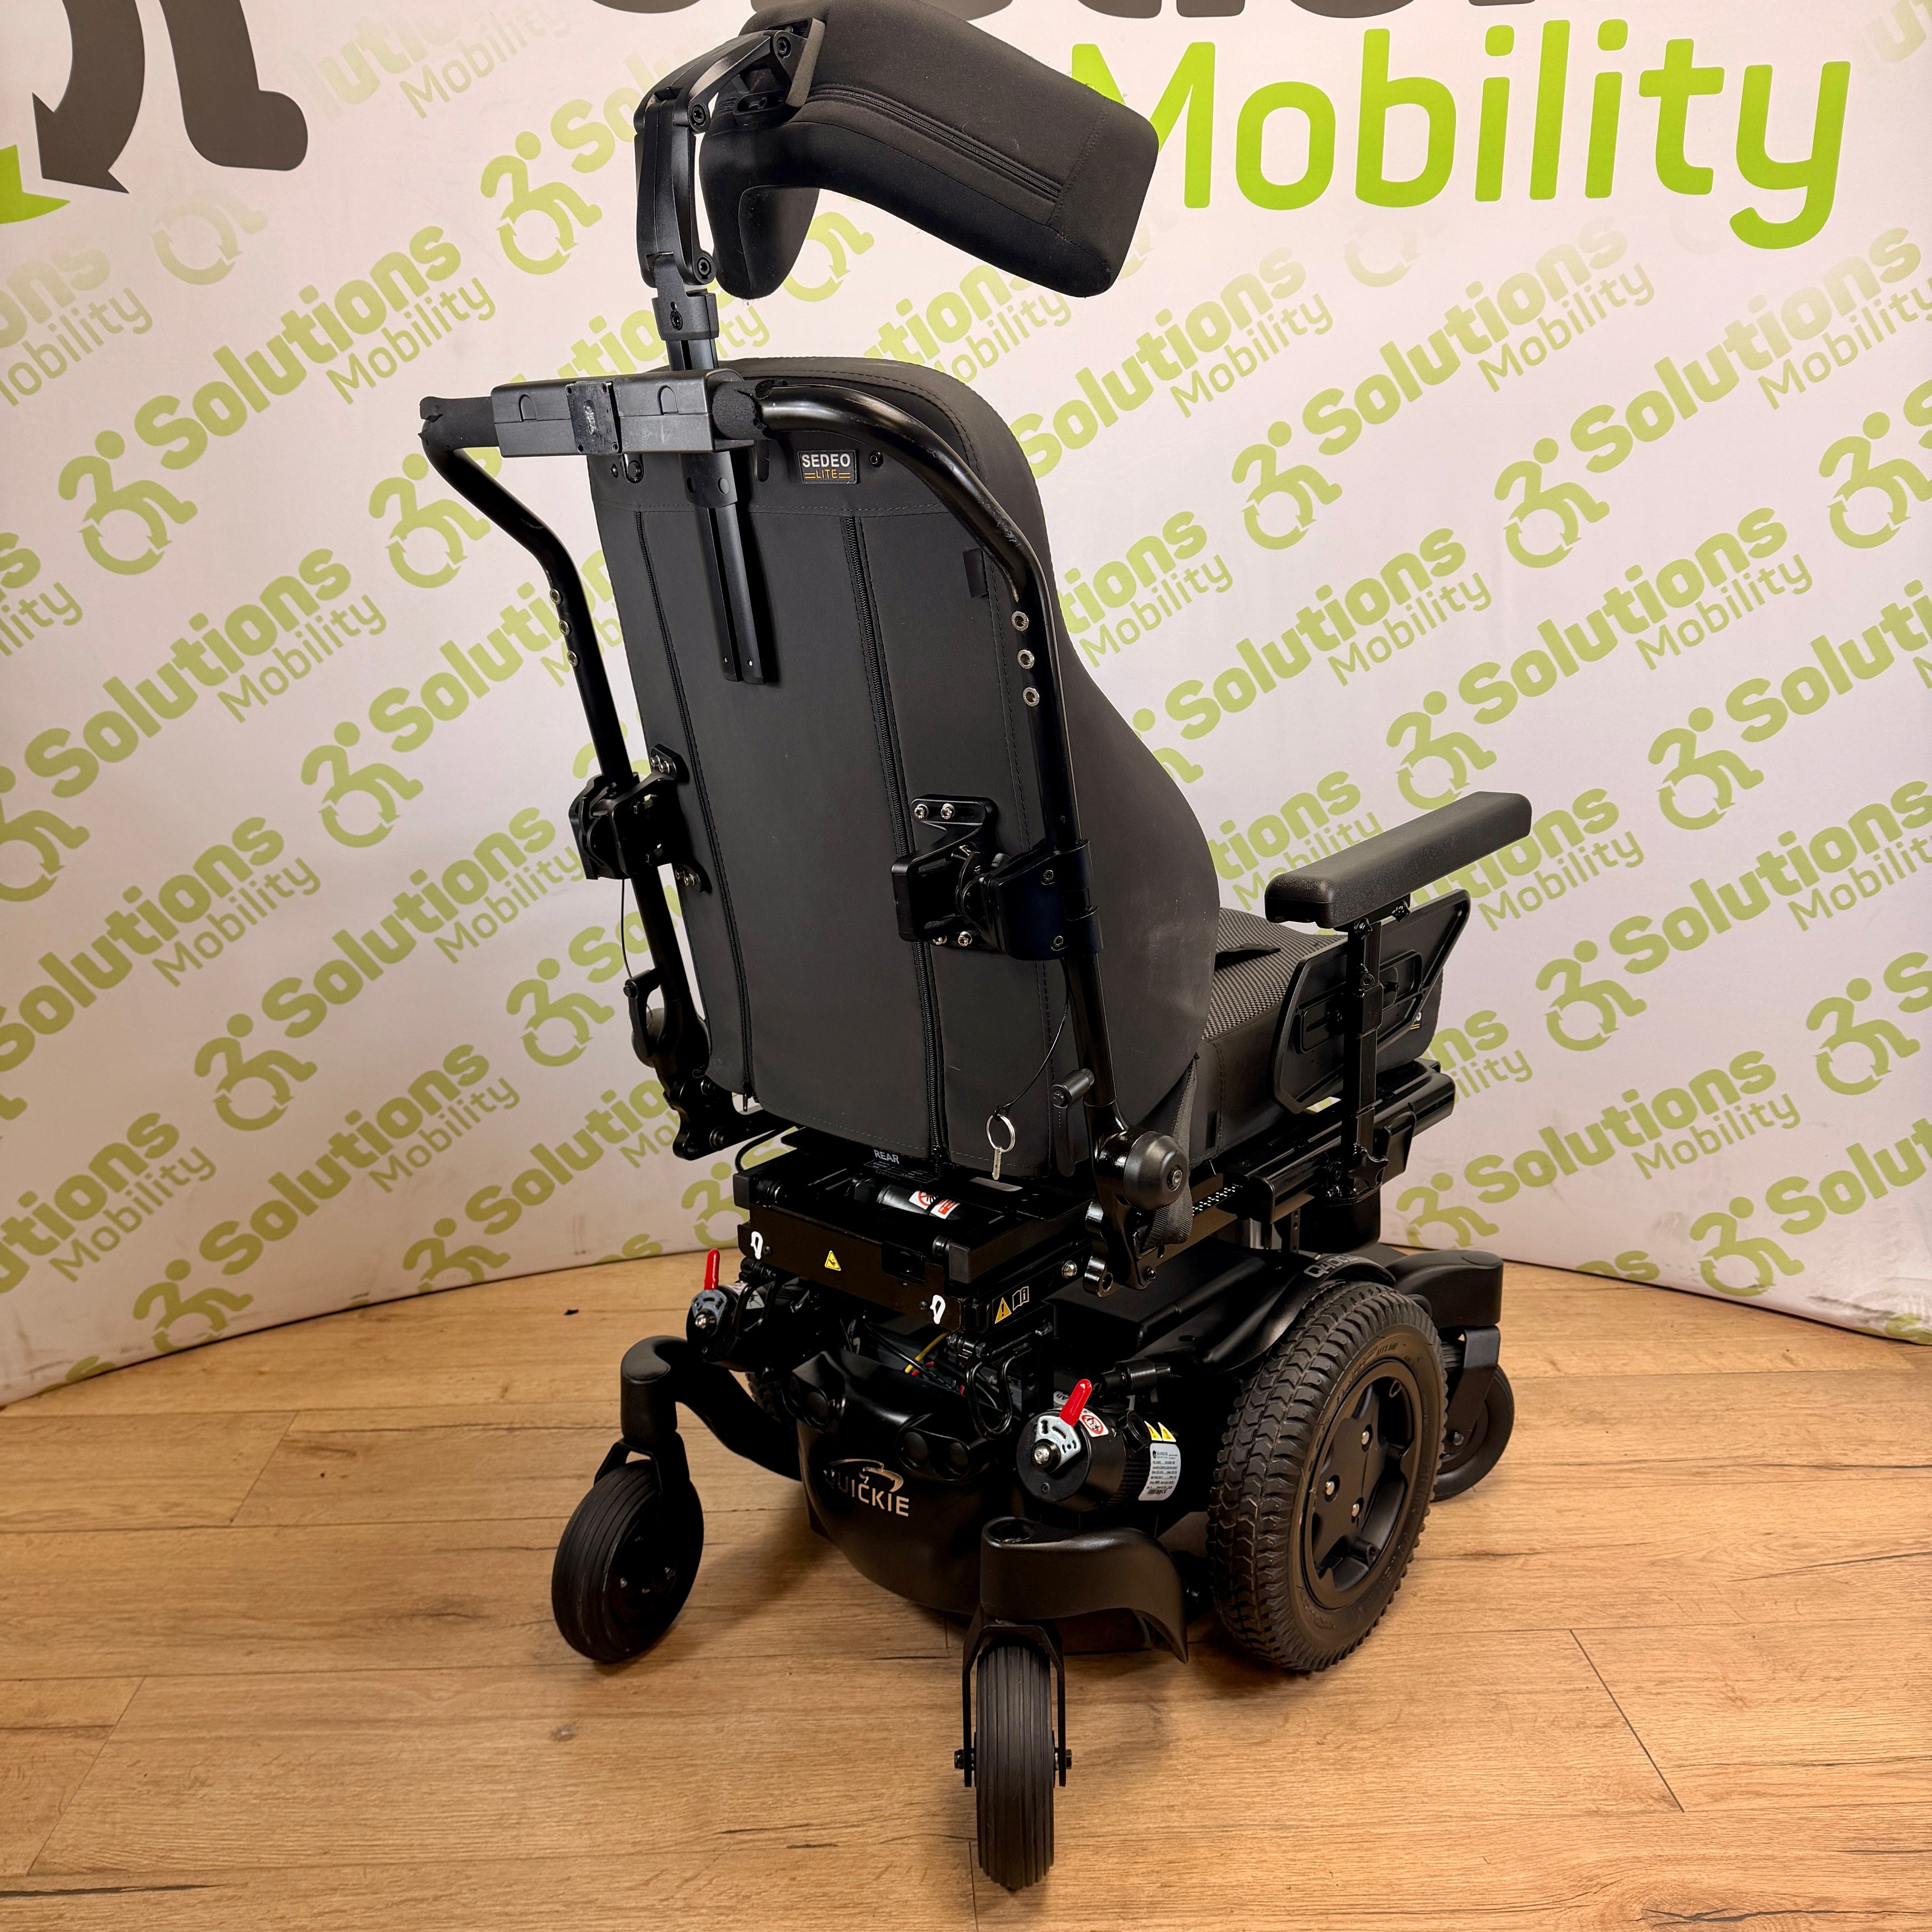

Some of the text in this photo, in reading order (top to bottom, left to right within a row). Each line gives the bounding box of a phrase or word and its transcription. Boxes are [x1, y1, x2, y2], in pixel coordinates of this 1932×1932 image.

[1072, 19, 1851, 249] Mobility
[134, 225, 462, 470] Solutions
[325, 277, 496, 405] Mobility
[934, 291, 1072, 383] obility
[1010, 247, 1306, 479] Solutions
[1169, 293, 1333, 418] Mobility
[1302, 216, 1628, 455] Solutions
[1477, 264, 1654, 392] Mobility
[1570, 227, 1921, 473] Solutions
[802, 453, 851, 468] SEDEO
[815, 469, 837, 479] LITE
[1058, 511, 1207, 634] tions
[1079, 554, 1233, 667] Mobility
[1165, 528, 1466, 740] Solutions
[1328, 572, 1492, 686] Mobility
[1458, 507, 1788, 724] Solutions
[1635, 553, 1813, 670] Mobility
[24, 548, 351, 798] Solutions
[217, 594, 387, 722] Mobility
[1208, 771, 1361, 880] tions
[1477, 831, 1644, 932] Mobility
[1609, 781, 1932, 974] Solutions
[1788, 835, 1932, 931] Mobilit
[152, 857, 321, 987] Mobility
[262, 807, 556, 1038] Solutions
[435, 846, 584, 964] Mobility
[368, 1077, 520, 1193] Mobility
[1454, 1050, 1533, 1104] ility
[1463, 1050, 1776, 1204] Solutions
[1631, 1093, 1801, 1180] Mobility
[49, 1147, 216, 1282] Mobility
[198, 1044, 489, 1275] Solutions
[465, 1080, 669, 1235] Solutio
[874, 1150, 900, 1164] REAR
